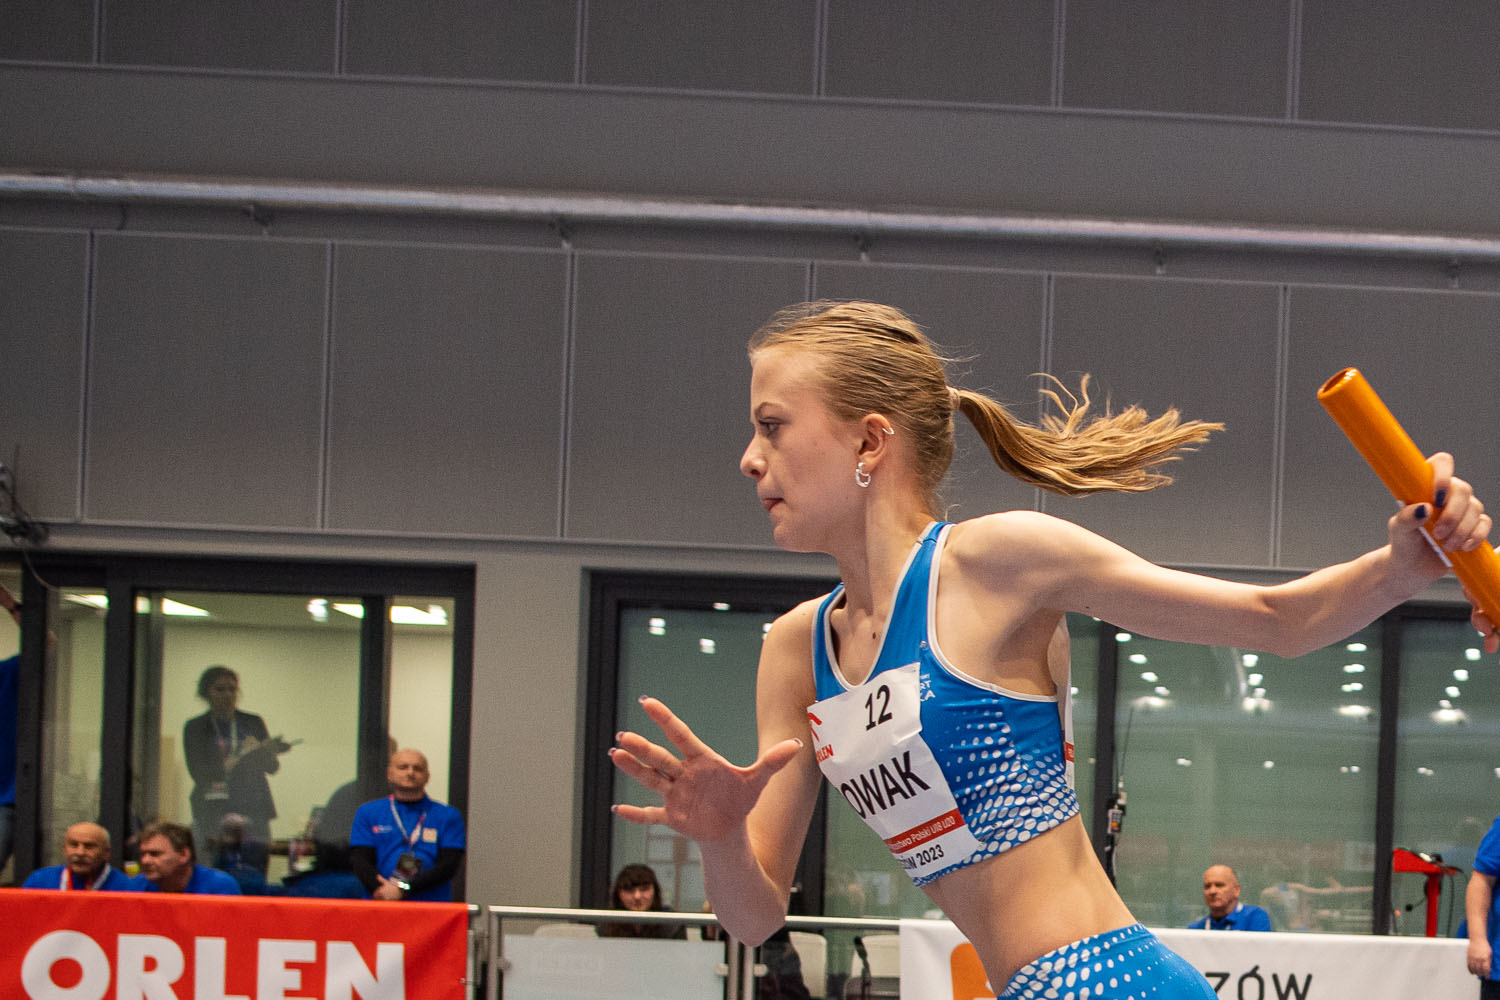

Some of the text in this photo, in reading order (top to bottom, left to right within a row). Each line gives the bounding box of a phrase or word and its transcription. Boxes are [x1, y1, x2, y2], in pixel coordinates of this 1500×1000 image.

[865, 685, 893, 732] 12
[840, 750, 931, 819] OWAK
[915, 844, 944, 866] 2023
